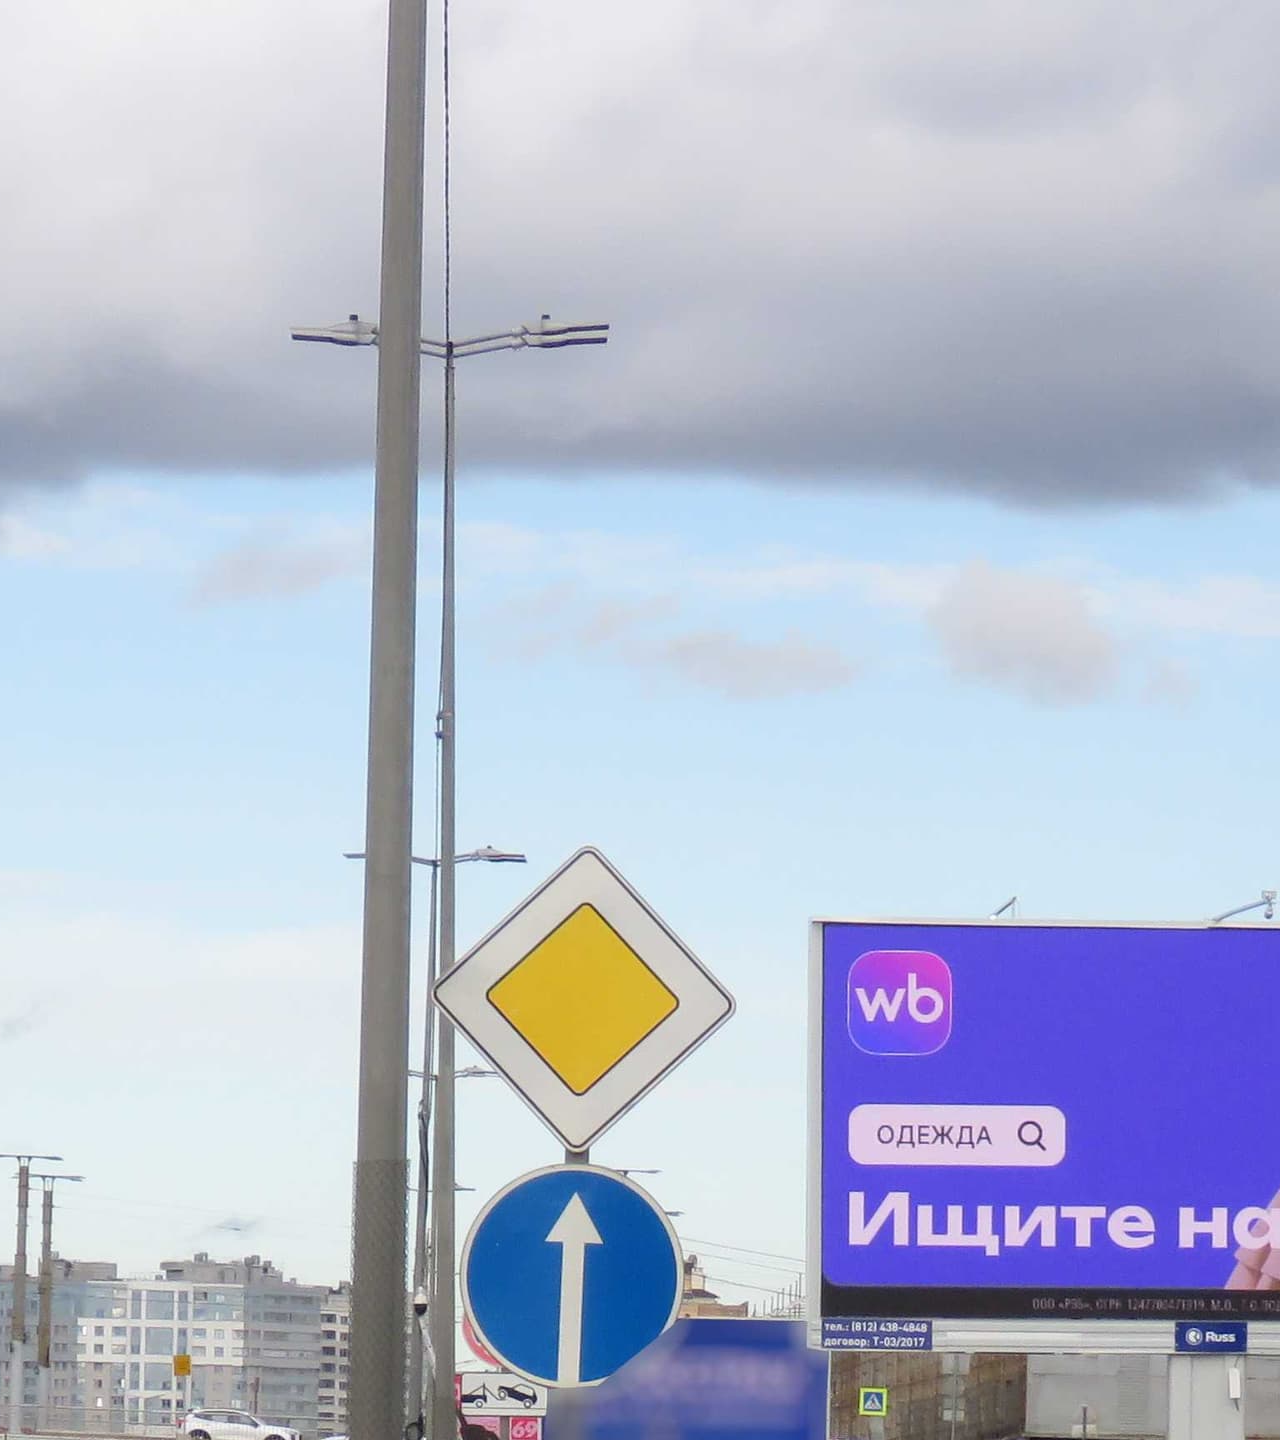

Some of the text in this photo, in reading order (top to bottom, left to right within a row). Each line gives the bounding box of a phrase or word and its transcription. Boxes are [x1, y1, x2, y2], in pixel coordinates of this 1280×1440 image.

[855, 972, 944, 1023] wb
[877, 1124, 992, 1149] ОДЕЖДА
[848, 1191, 1155, 1257] Ищите
[824, 1321, 928, 1333] тел.: (812) 438-4848
[823, 1337, 871, 1348] договор:
[1205, 1331, 1237, 1343] Russ
